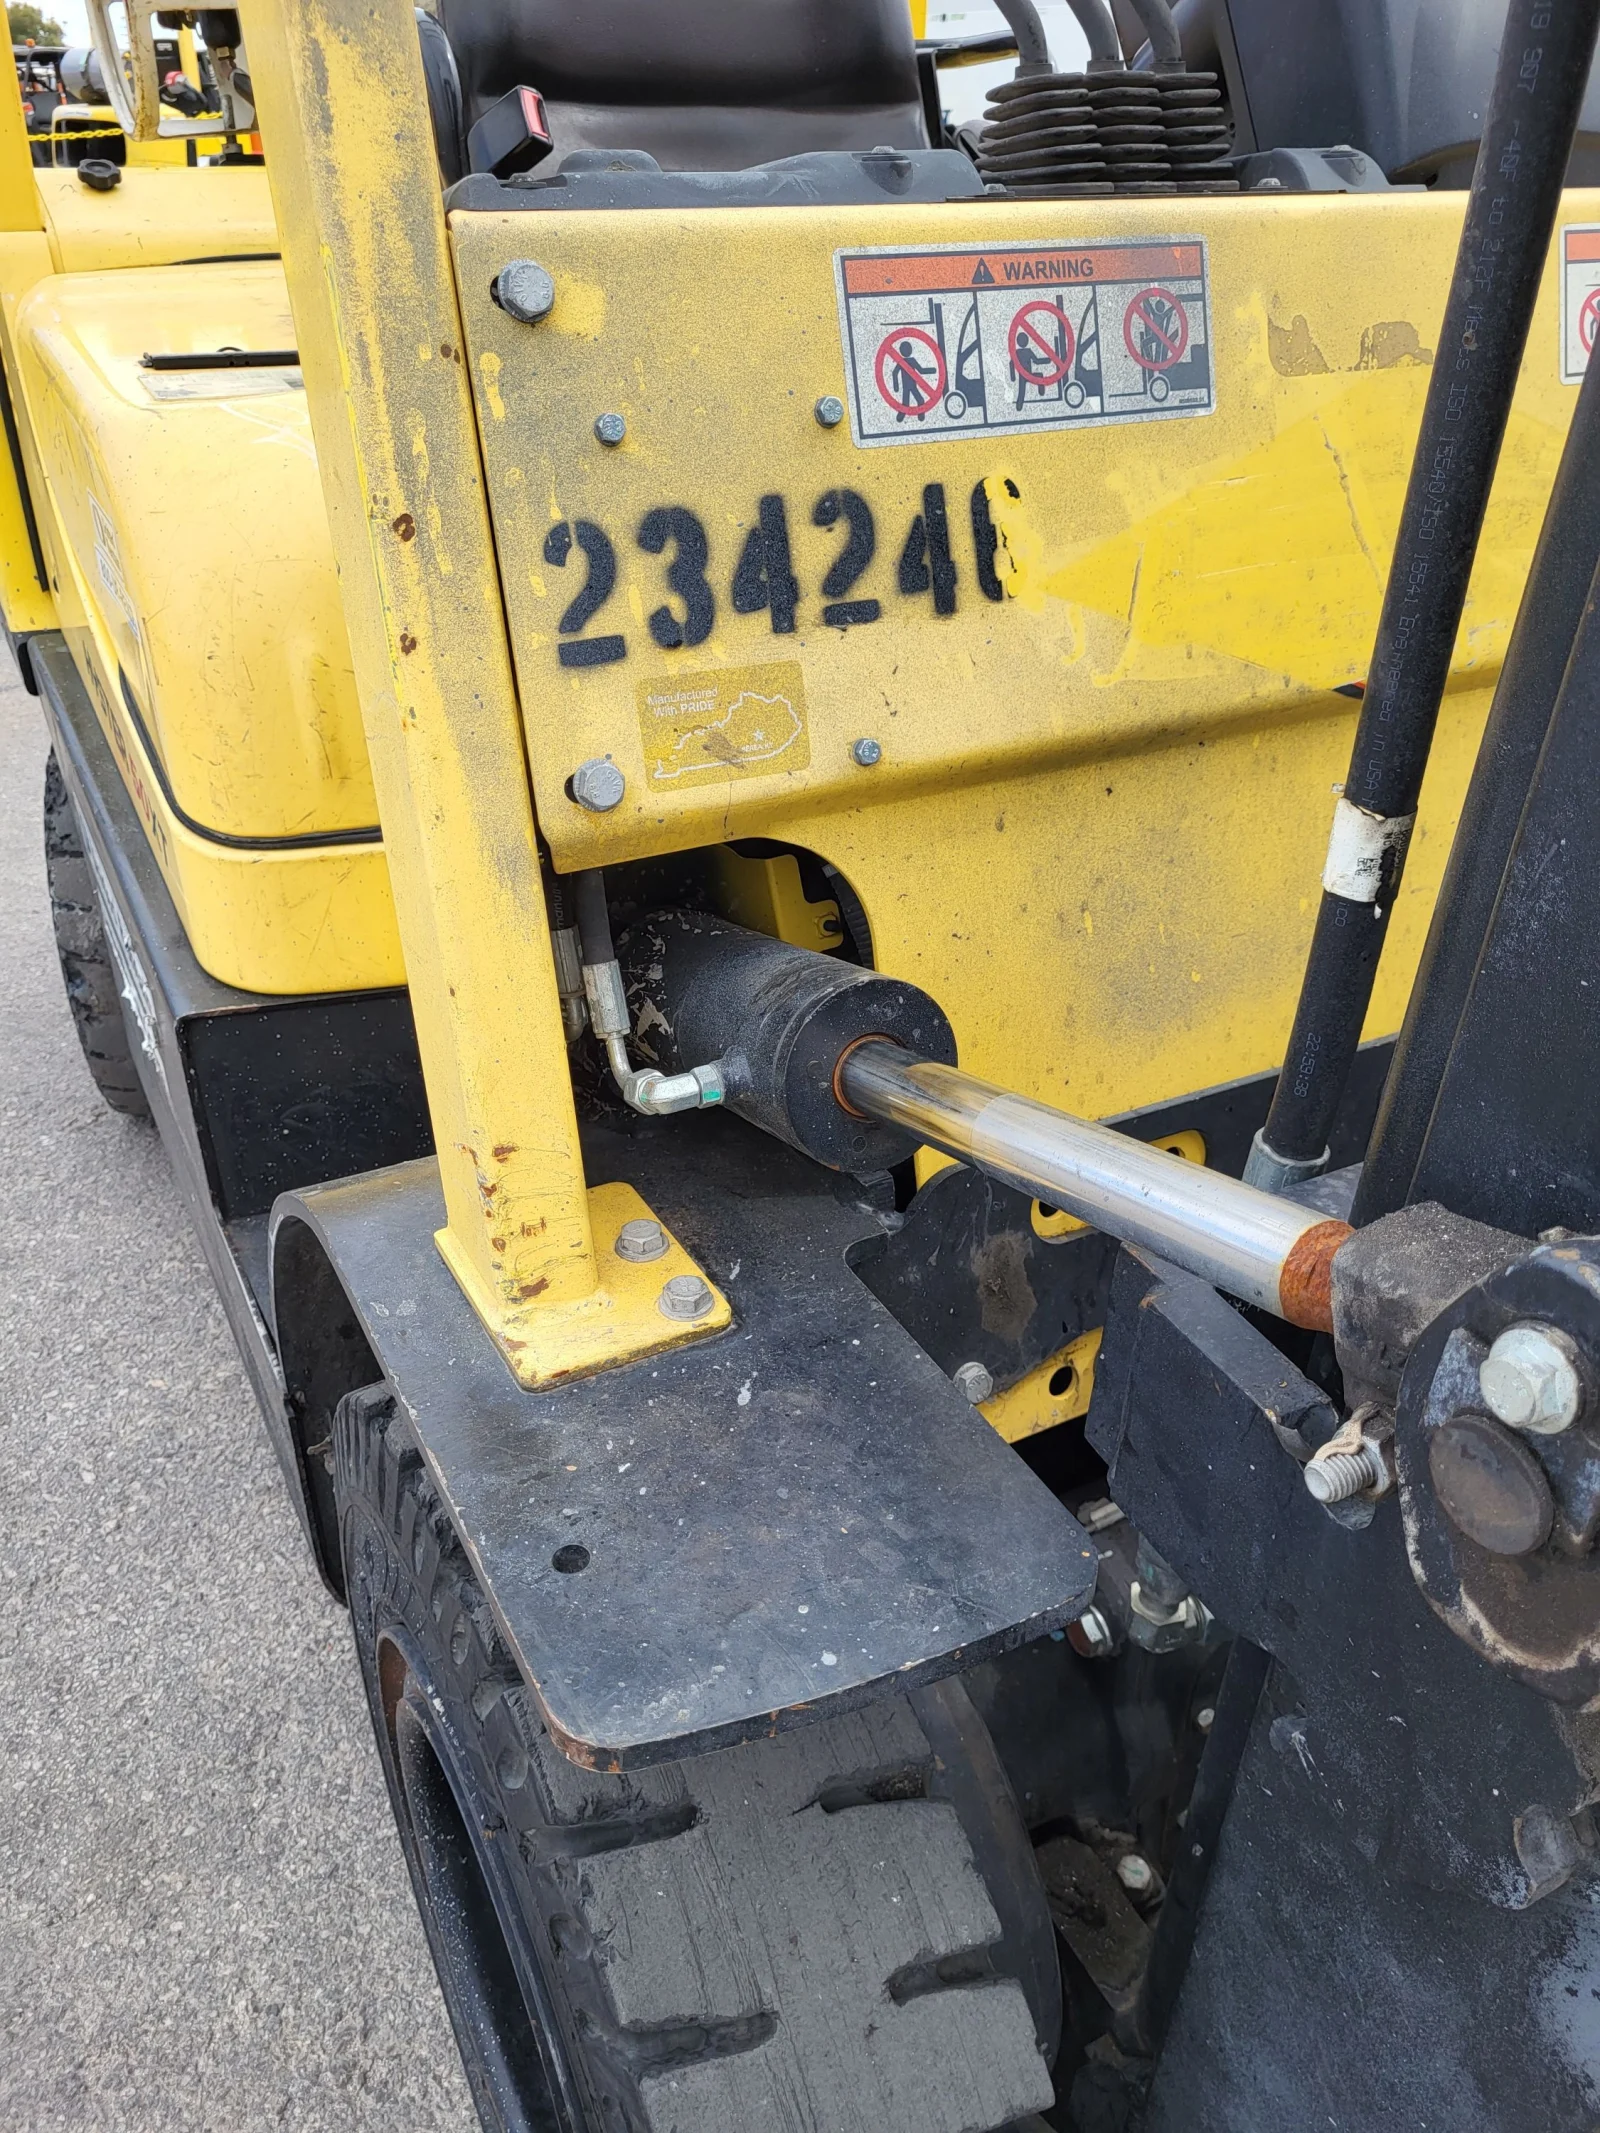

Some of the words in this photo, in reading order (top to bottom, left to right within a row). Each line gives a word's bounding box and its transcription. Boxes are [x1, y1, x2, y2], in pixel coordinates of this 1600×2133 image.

[1517, 48, 1543, 94] 907
[1489, 196, 1505, 225] to
[1003, 257, 1094, 281] WARNING
[1475, 238, 1502, 293] 212F
[1456, 305, 1484, 371] Mets
[1445, 383, 1467, 421] ISO
[1404, 553, 1429, 603] 15541
[647, 686, 718, 706] Manufactured
[654, 704, 678, 718] With
[680, 700, 715, 715] PRIDE
[1372, 732, 1388, 752] in
[1294, 1032, 1321, 1098] 22:59:38
